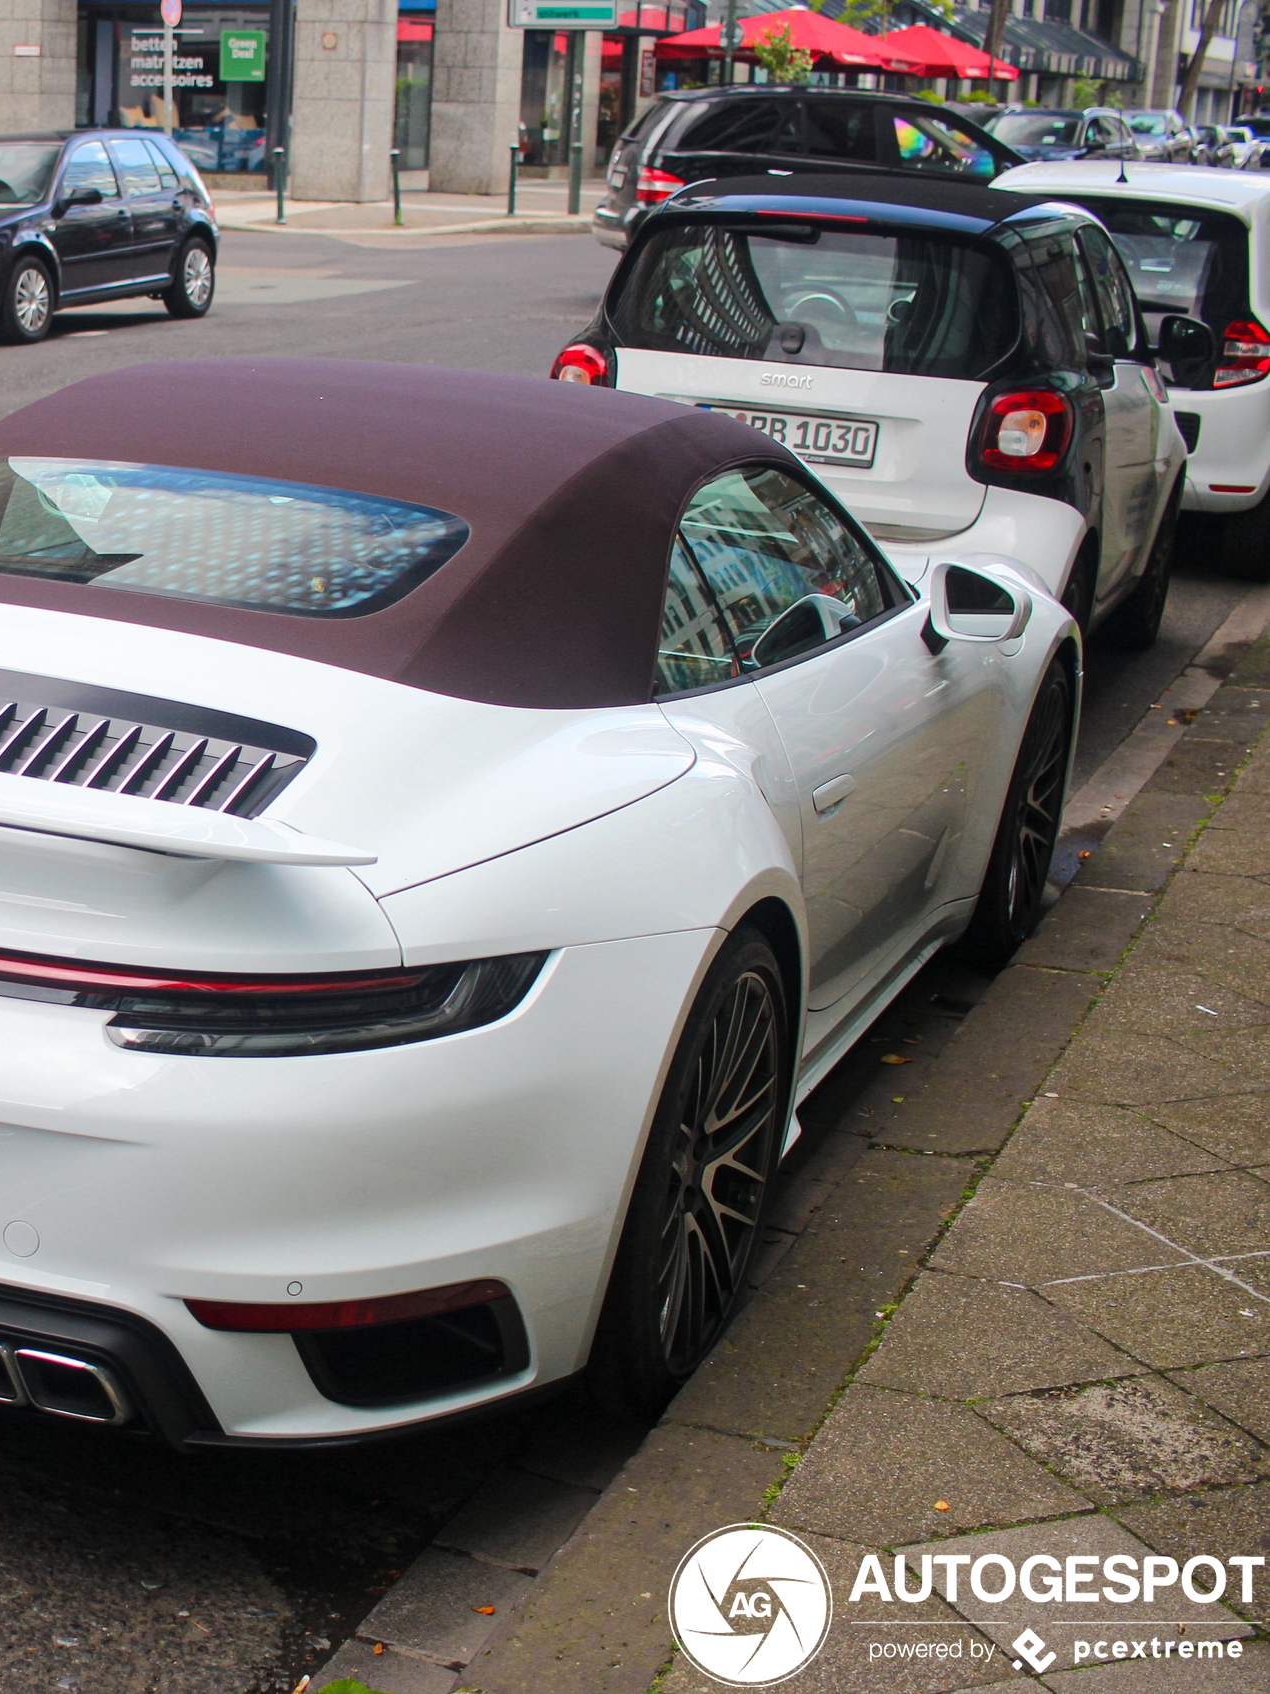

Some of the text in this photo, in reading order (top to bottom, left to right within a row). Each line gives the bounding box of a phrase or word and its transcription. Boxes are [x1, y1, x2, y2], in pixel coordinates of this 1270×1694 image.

[131, 36, 178, 52] betten
[228, 38, 258, 49] Green
[131, 55, 204, 70] matrtzen
[131, 72, 214, 88] accesoires
[760, 372, 813, 390] smart
[792, 420, 871, 456] 1030
